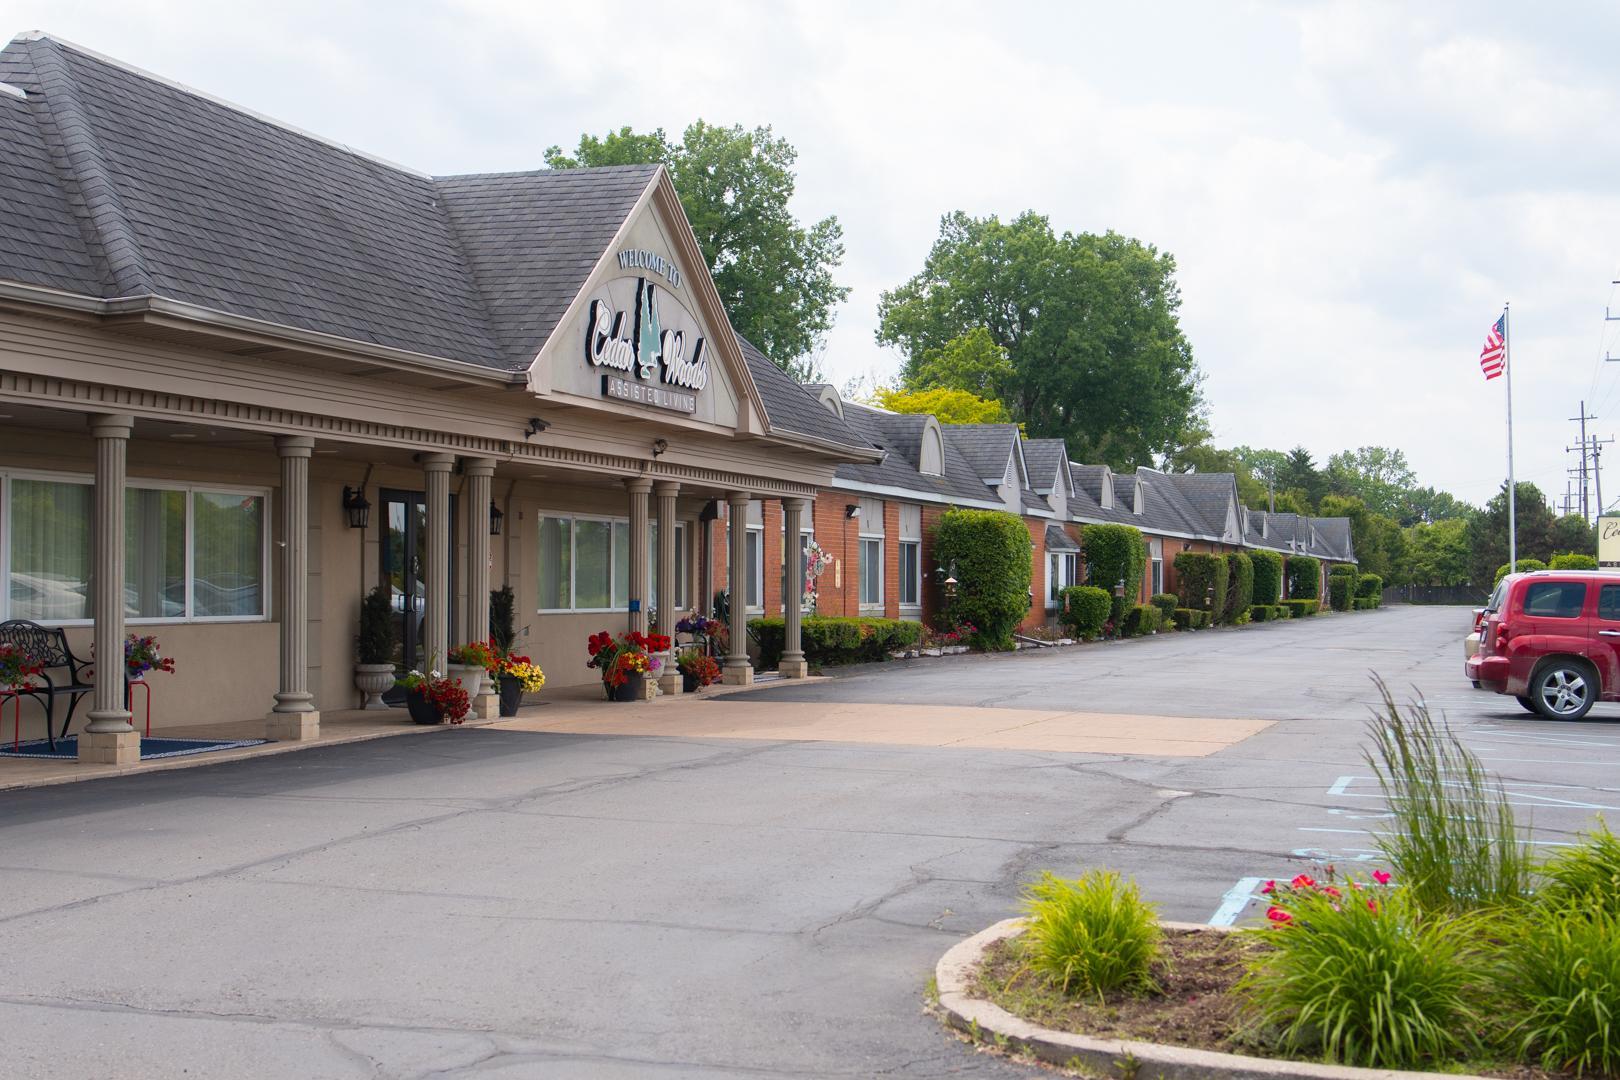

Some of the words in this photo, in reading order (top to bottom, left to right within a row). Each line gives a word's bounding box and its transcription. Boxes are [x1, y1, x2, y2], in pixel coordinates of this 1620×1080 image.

[617, 249, 665, 276] WELCOME
[667, 263, 681, 289] TO
[587, 299, 635, 372] Cedar
[662, 329, 707, 391] Woods
[609, 380, 659, 404] ASSISTED
[663, 392, 695, 411] LIVING
